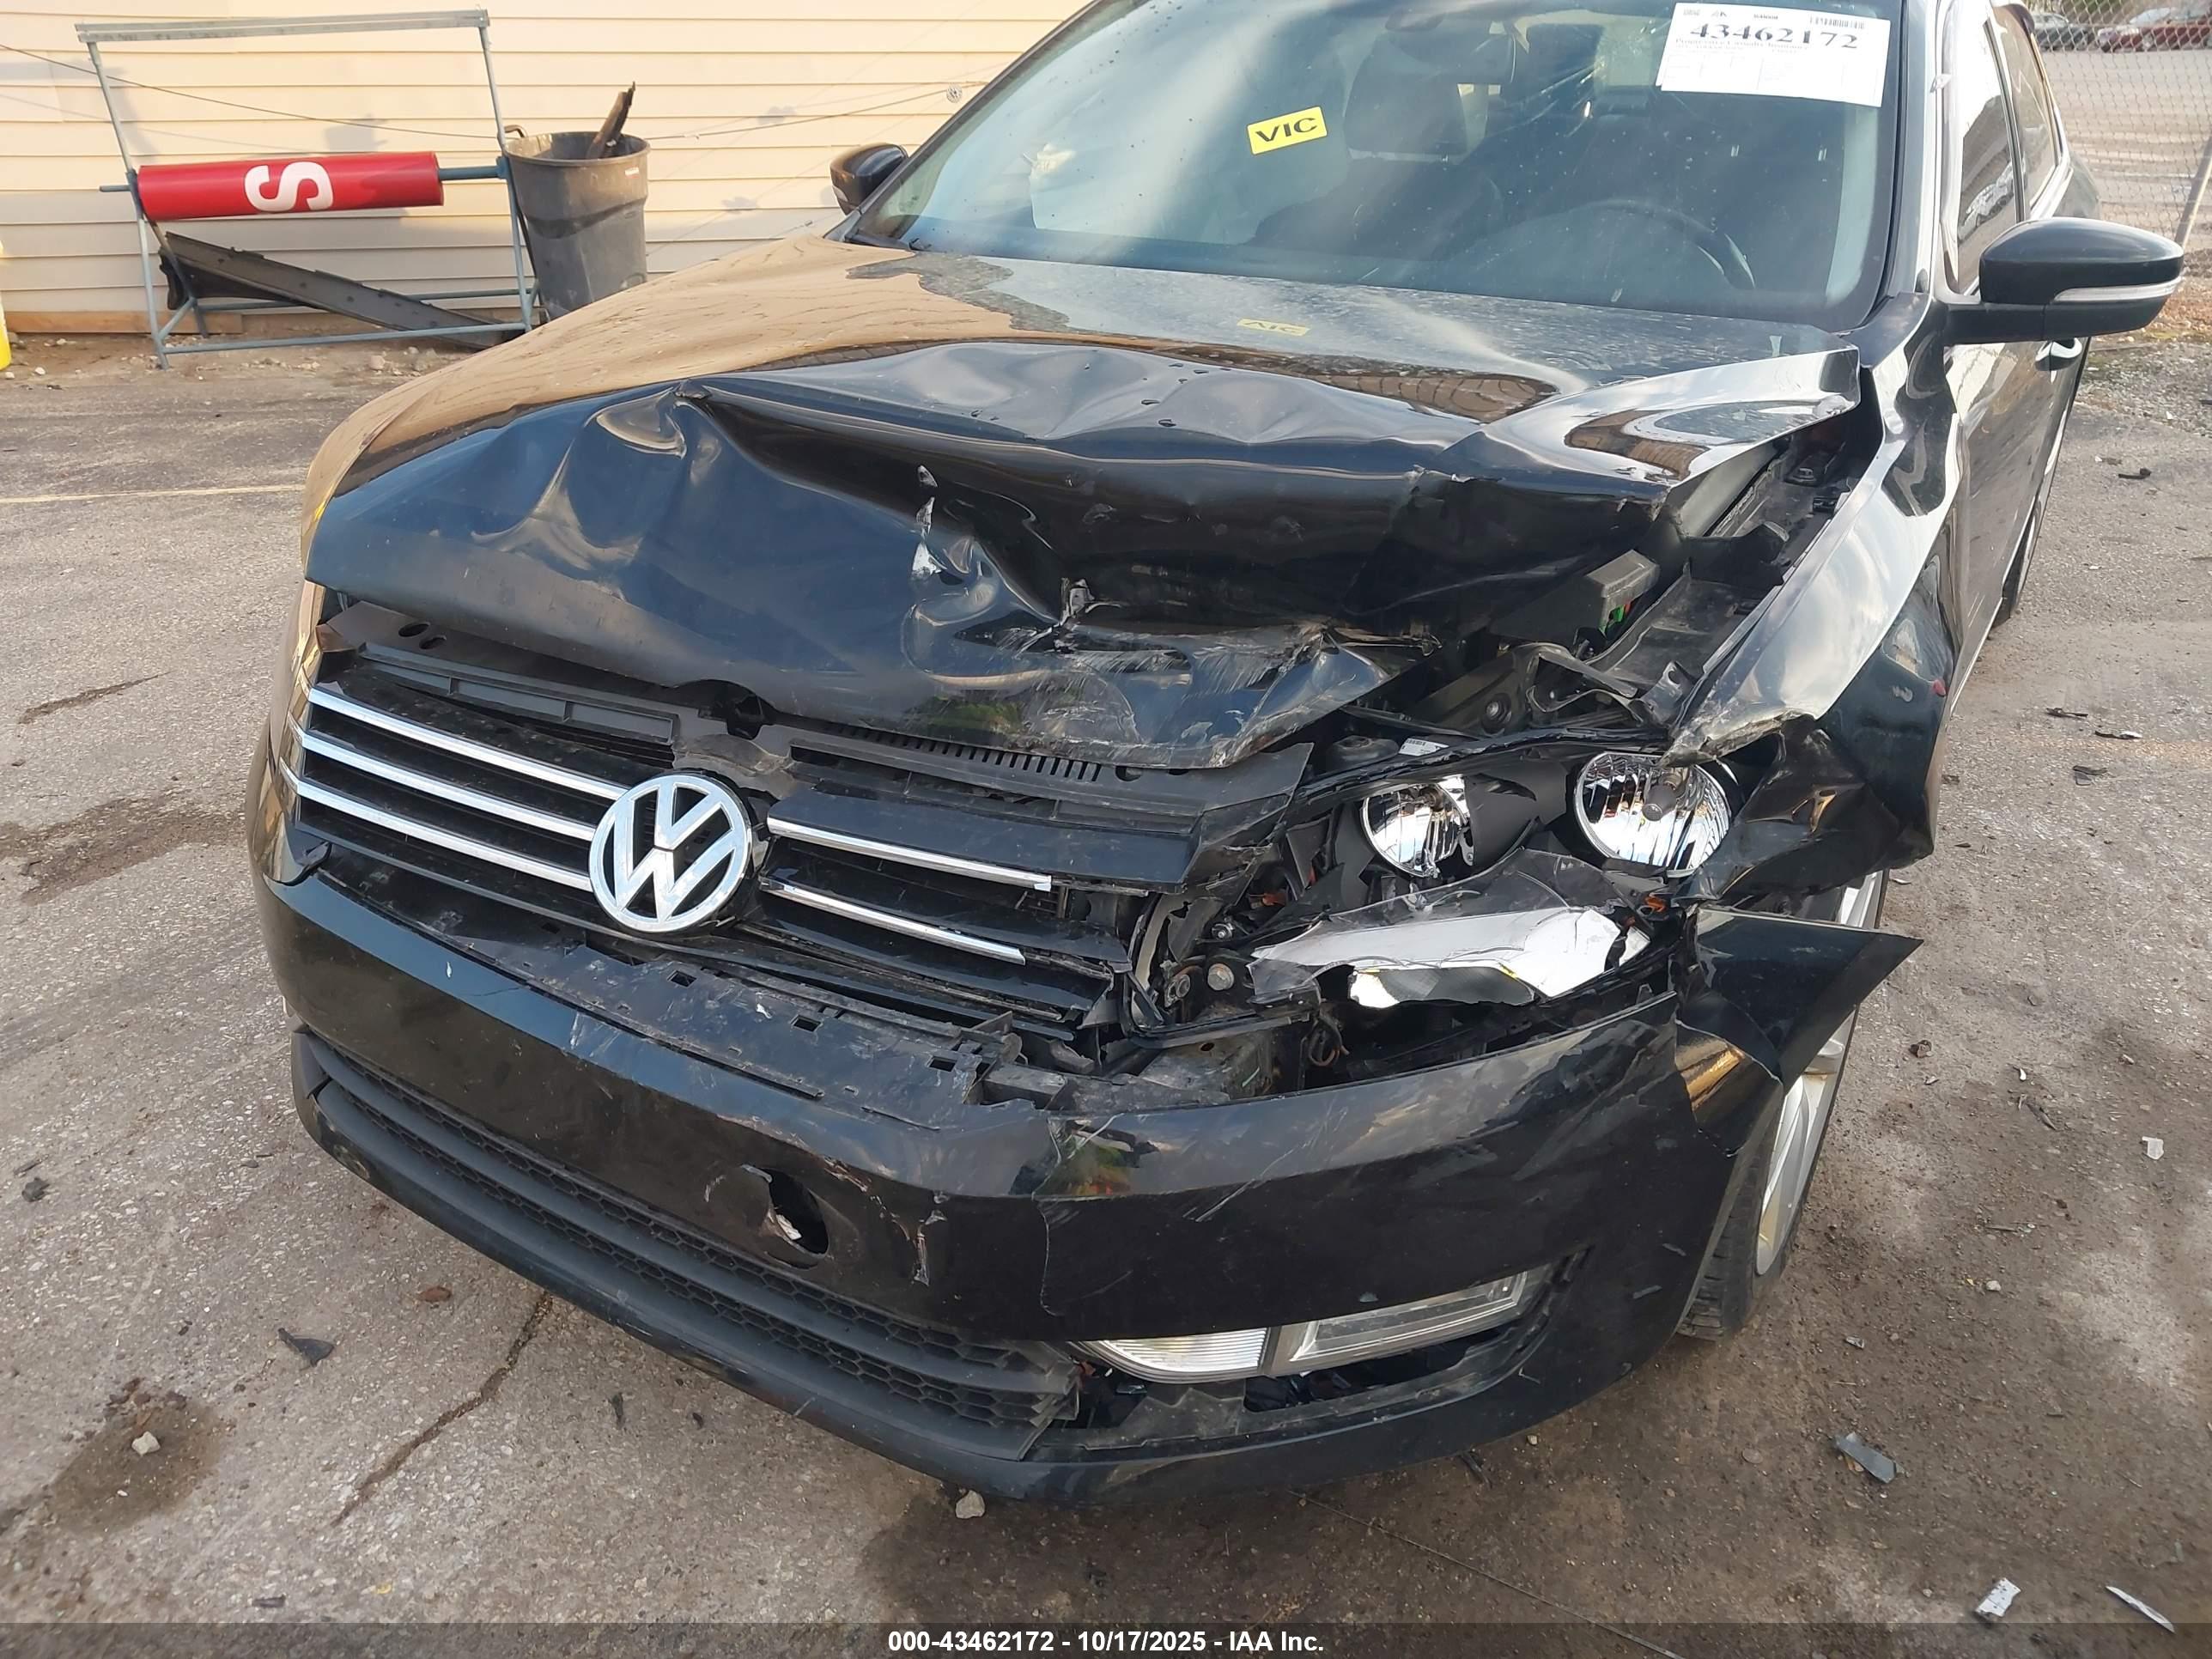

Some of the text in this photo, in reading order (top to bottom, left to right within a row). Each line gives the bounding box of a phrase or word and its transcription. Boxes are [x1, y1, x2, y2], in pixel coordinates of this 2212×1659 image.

[1690, 23, 1857, 49] 43462172
[1255, 117, 1318, 143] VIC
[244, 161, 333, 211] S
